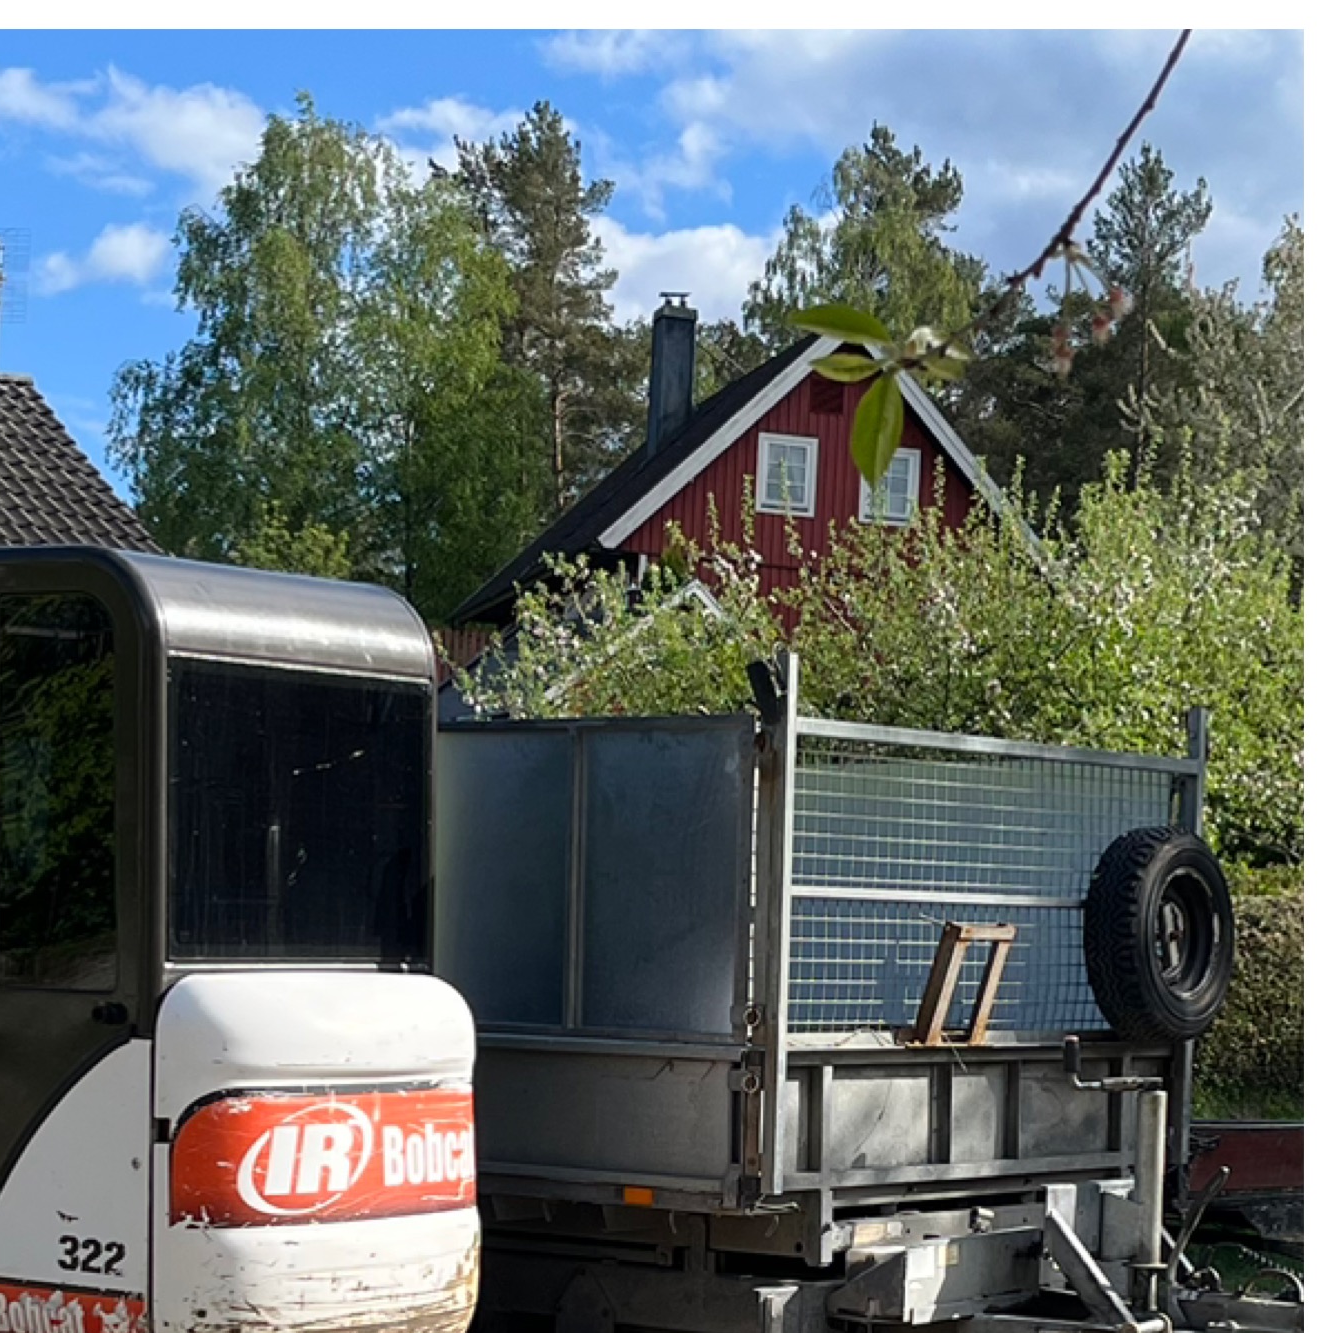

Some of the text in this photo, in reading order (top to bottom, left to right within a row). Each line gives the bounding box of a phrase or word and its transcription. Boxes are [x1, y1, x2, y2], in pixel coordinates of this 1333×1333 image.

[264, 1121, 475, 1196] IR Bobca
[58, 1234, 126, 1276] 322
